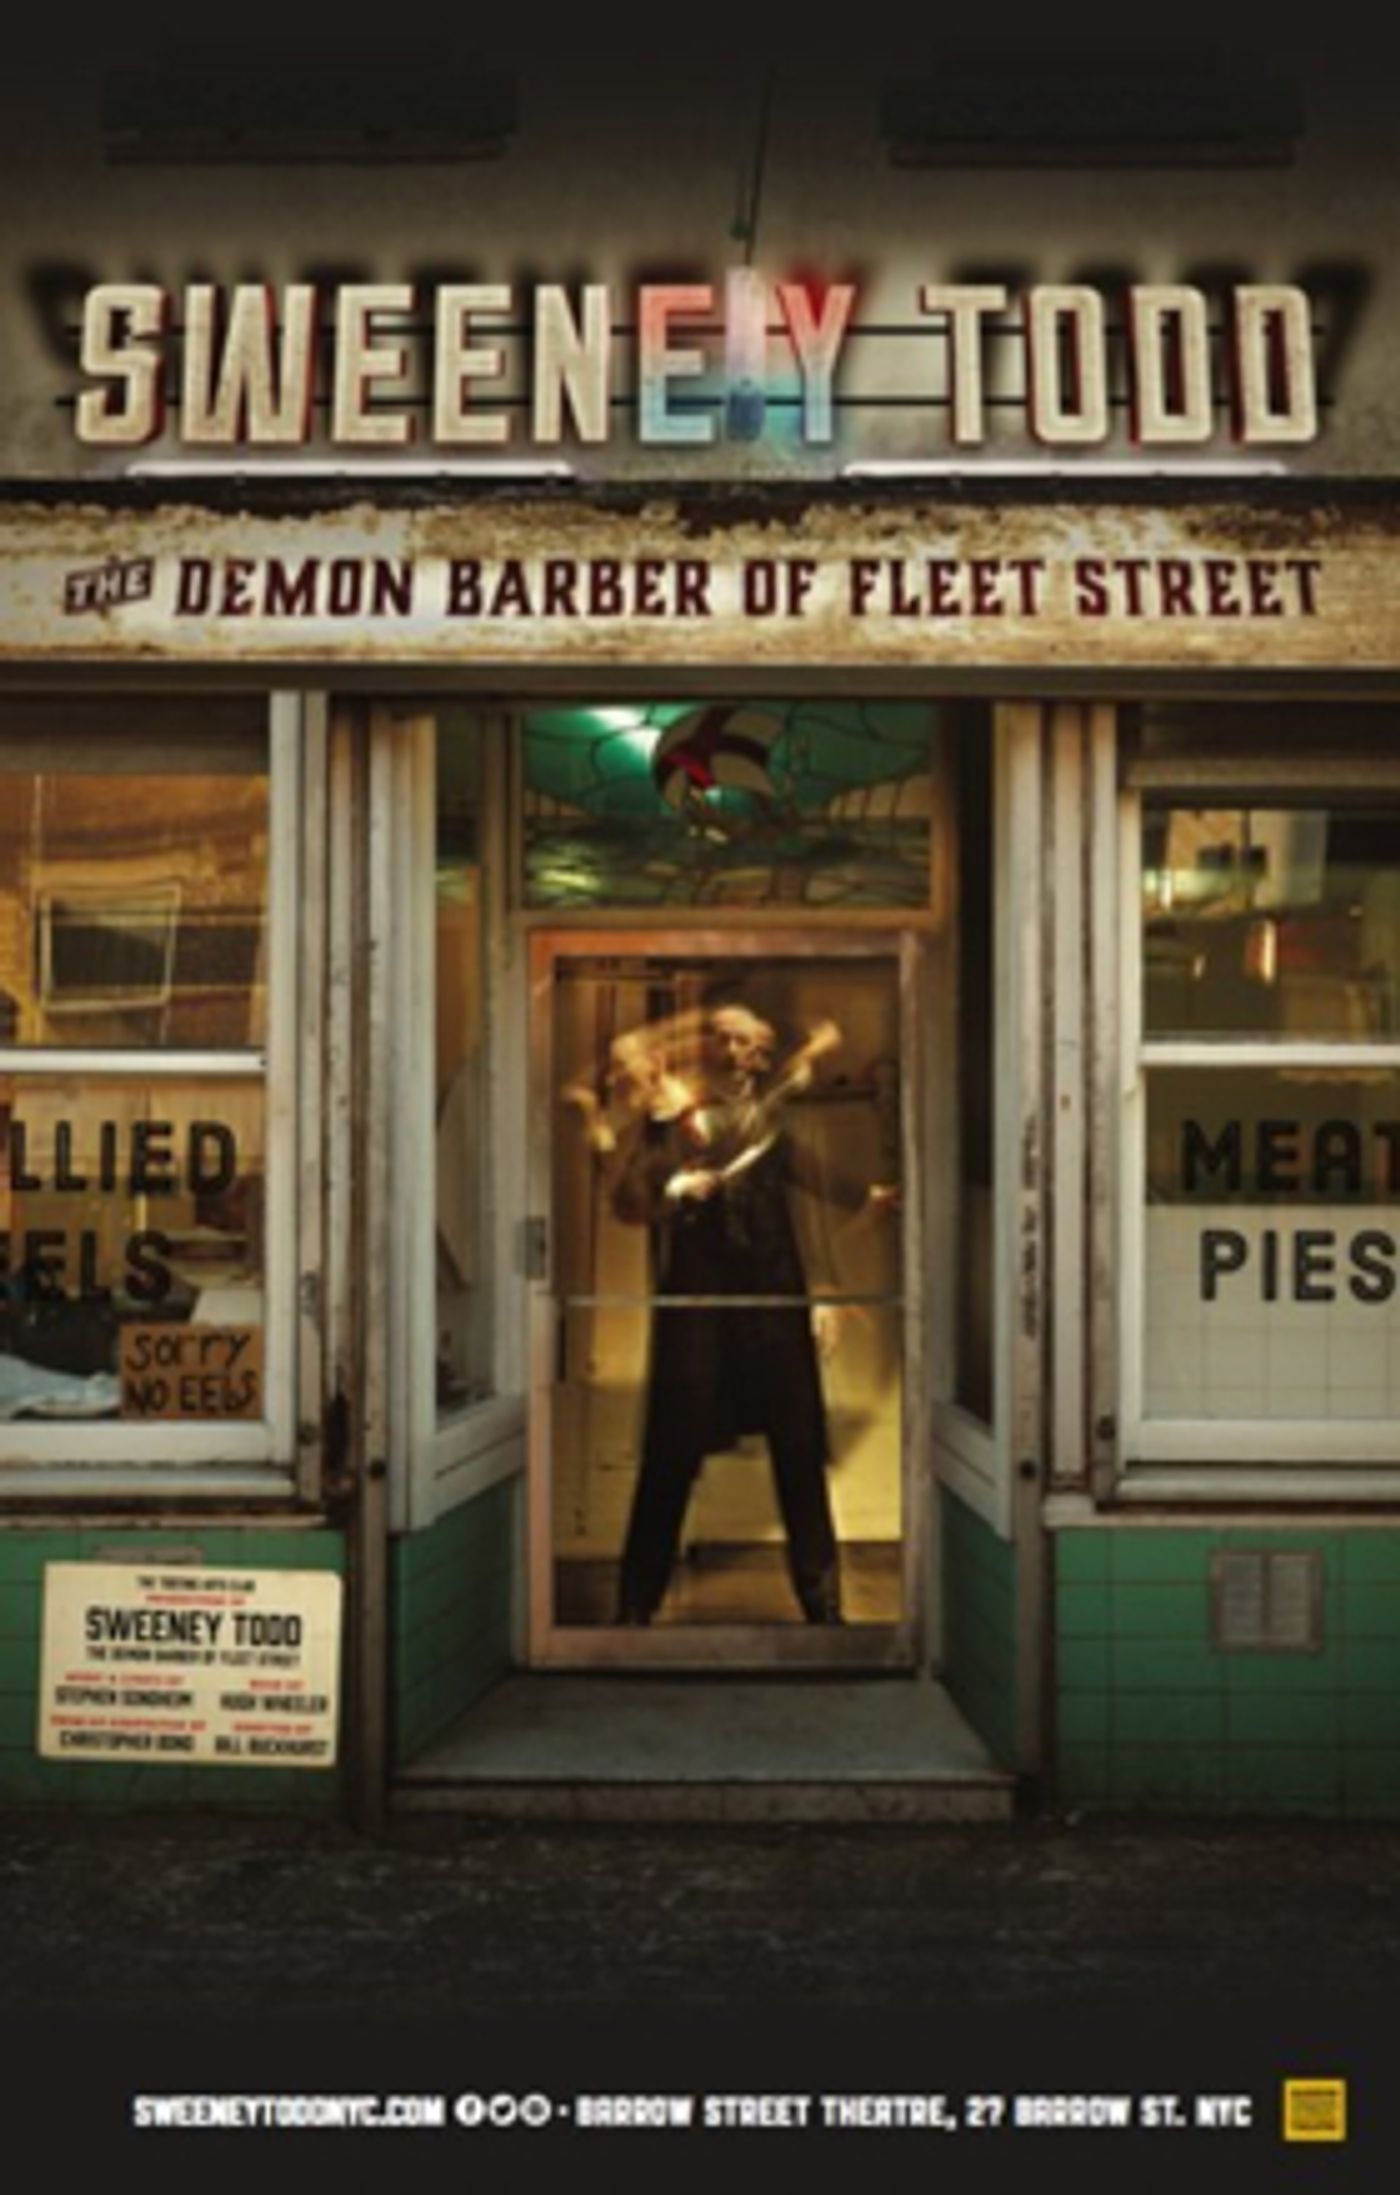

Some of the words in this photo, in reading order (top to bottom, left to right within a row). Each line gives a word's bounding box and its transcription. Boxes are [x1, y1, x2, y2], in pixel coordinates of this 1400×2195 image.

[76, 284, 854, 443] SWEENEY
[922, 284, 1319, 443] TODD
[64, 555, 155, 617] THE
[174, 558, 413, 618] DEMON
[445, 558, 711, 618] BARBER
[743, 558, 818, 618] OF
[849, 558, 1046, 618] FLEET
[1075, 558, 1322, 618] STREET
[1200, 1228, 1397, 1305] PIES
[86, 1606, 222, 1645] SWEENEY
[233, 1613, 301, 1646] TODD
